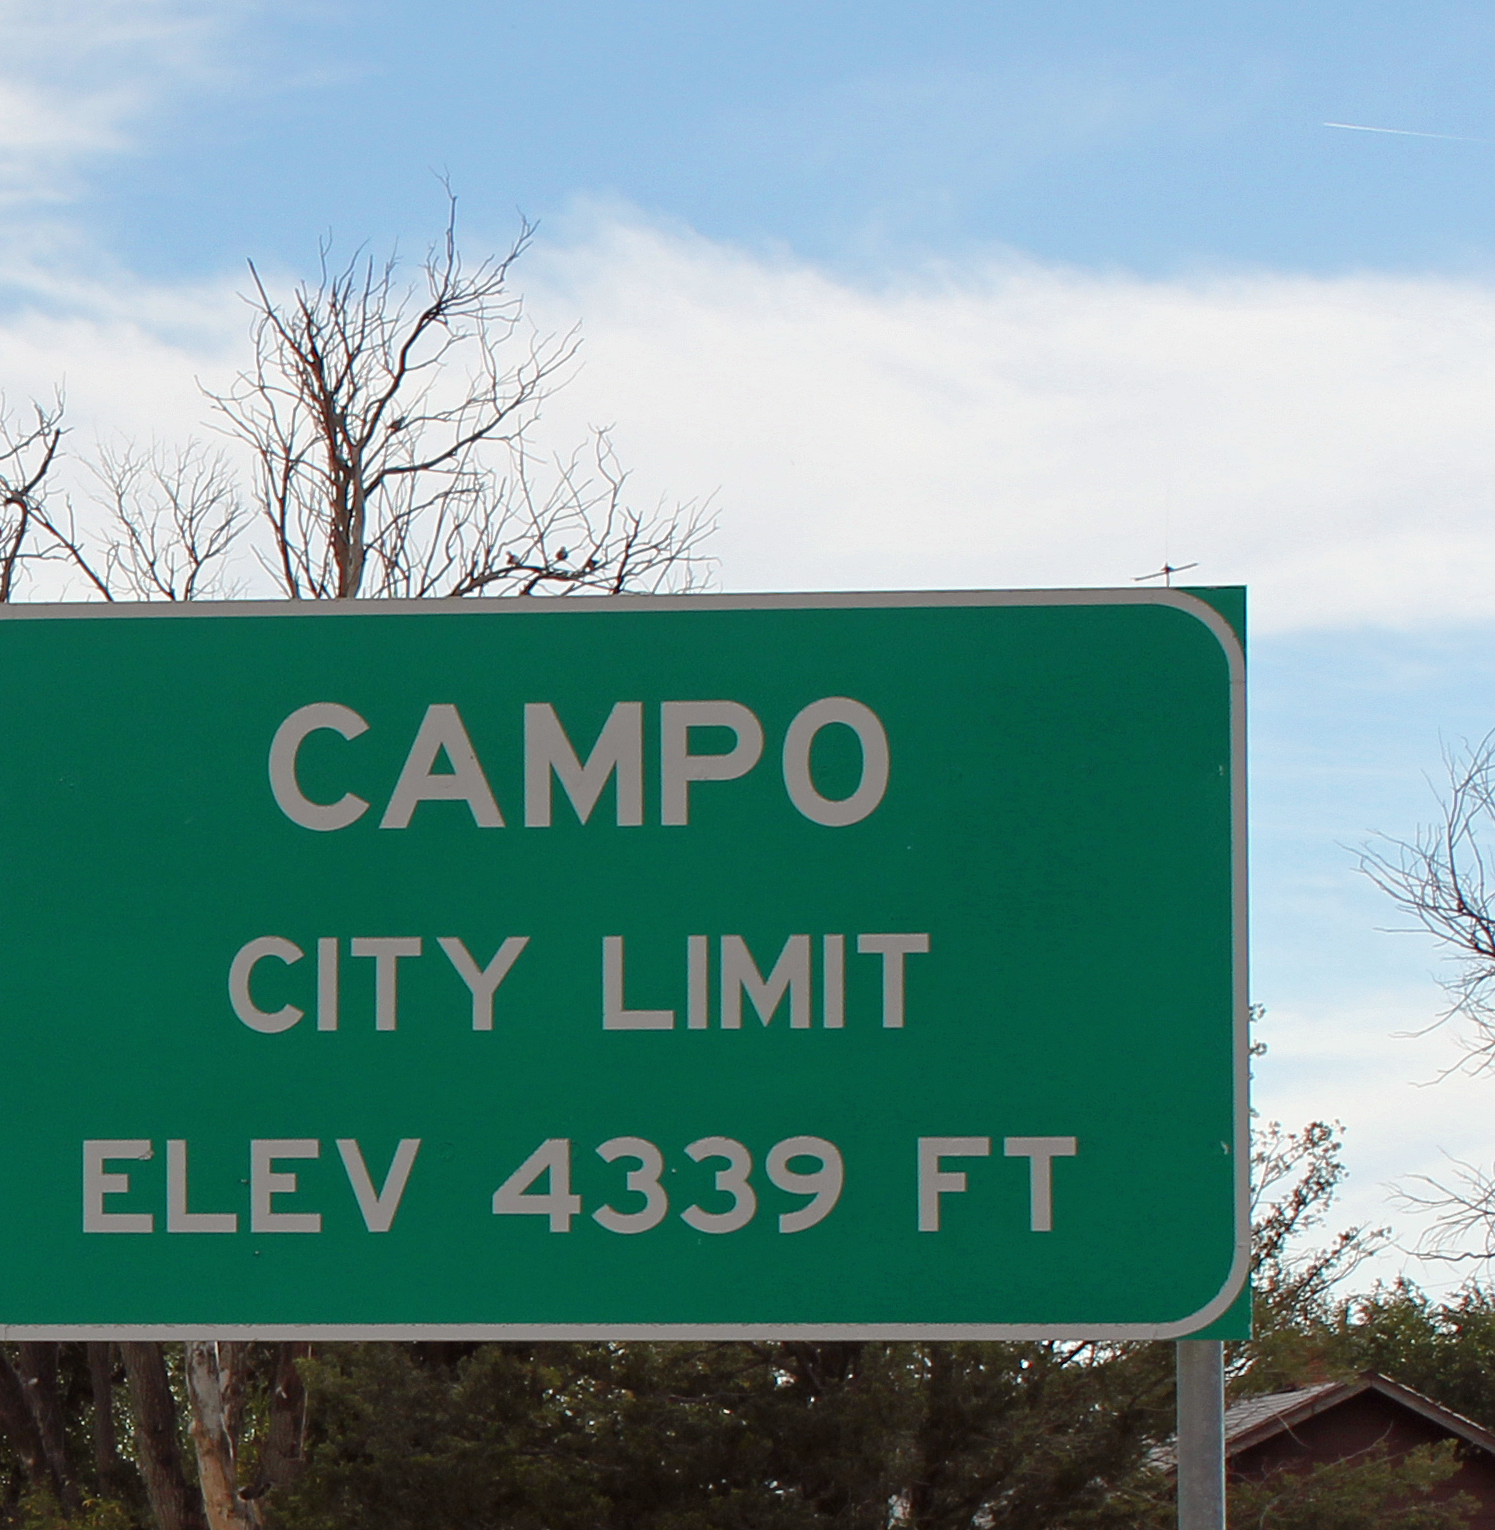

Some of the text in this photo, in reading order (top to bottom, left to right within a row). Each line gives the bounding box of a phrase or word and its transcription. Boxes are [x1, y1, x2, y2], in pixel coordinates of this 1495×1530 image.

[269, 697, 889, 831] CAMPO
[228, 934, 929, 1033] CITY LIMIT
[83, 1136, 1076, 1234] ELEV 4339 FT
